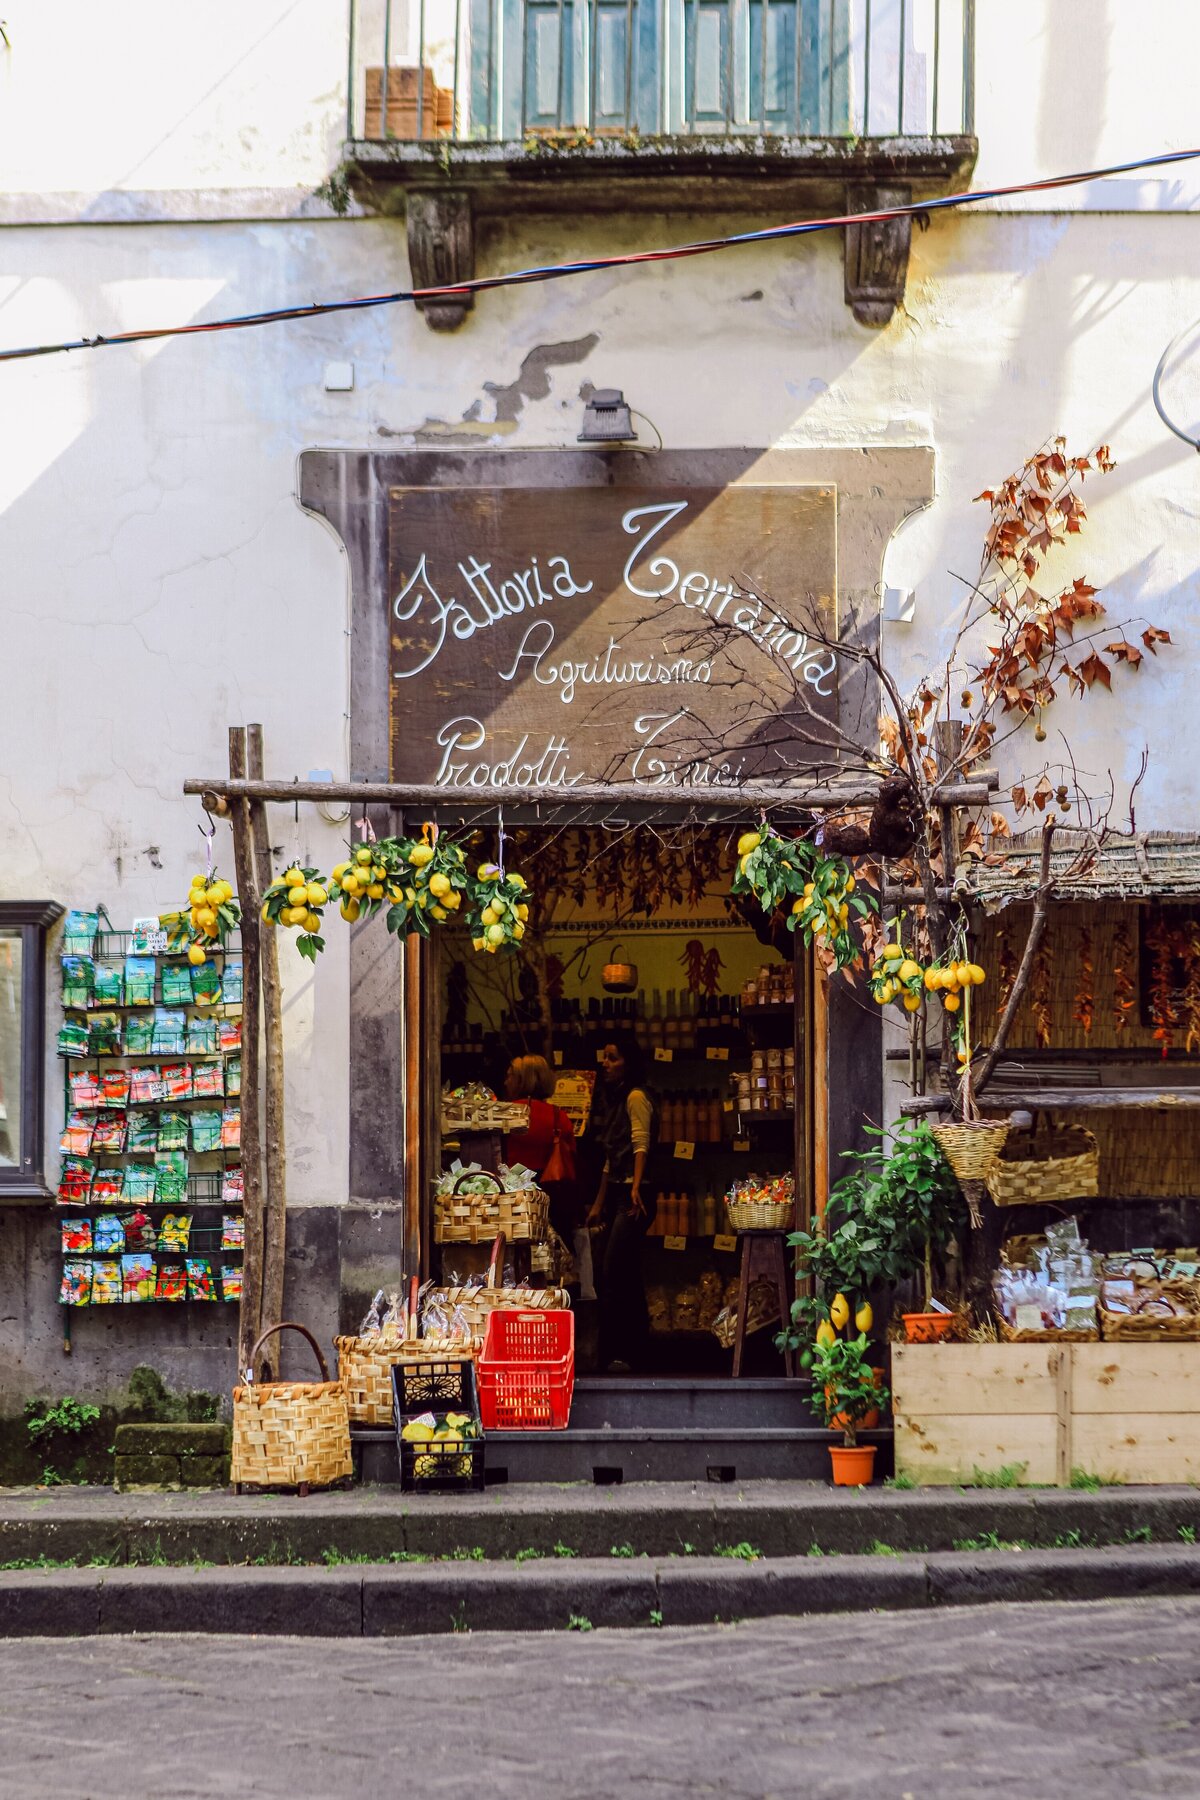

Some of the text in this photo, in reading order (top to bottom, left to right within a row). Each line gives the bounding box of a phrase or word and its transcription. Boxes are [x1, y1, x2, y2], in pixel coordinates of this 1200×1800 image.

[393, 500, 840, 697] Fattoria Terranova
[498, 619, 715, 703] Agriturismo
[434, 715, 585, 788] Prodotti
